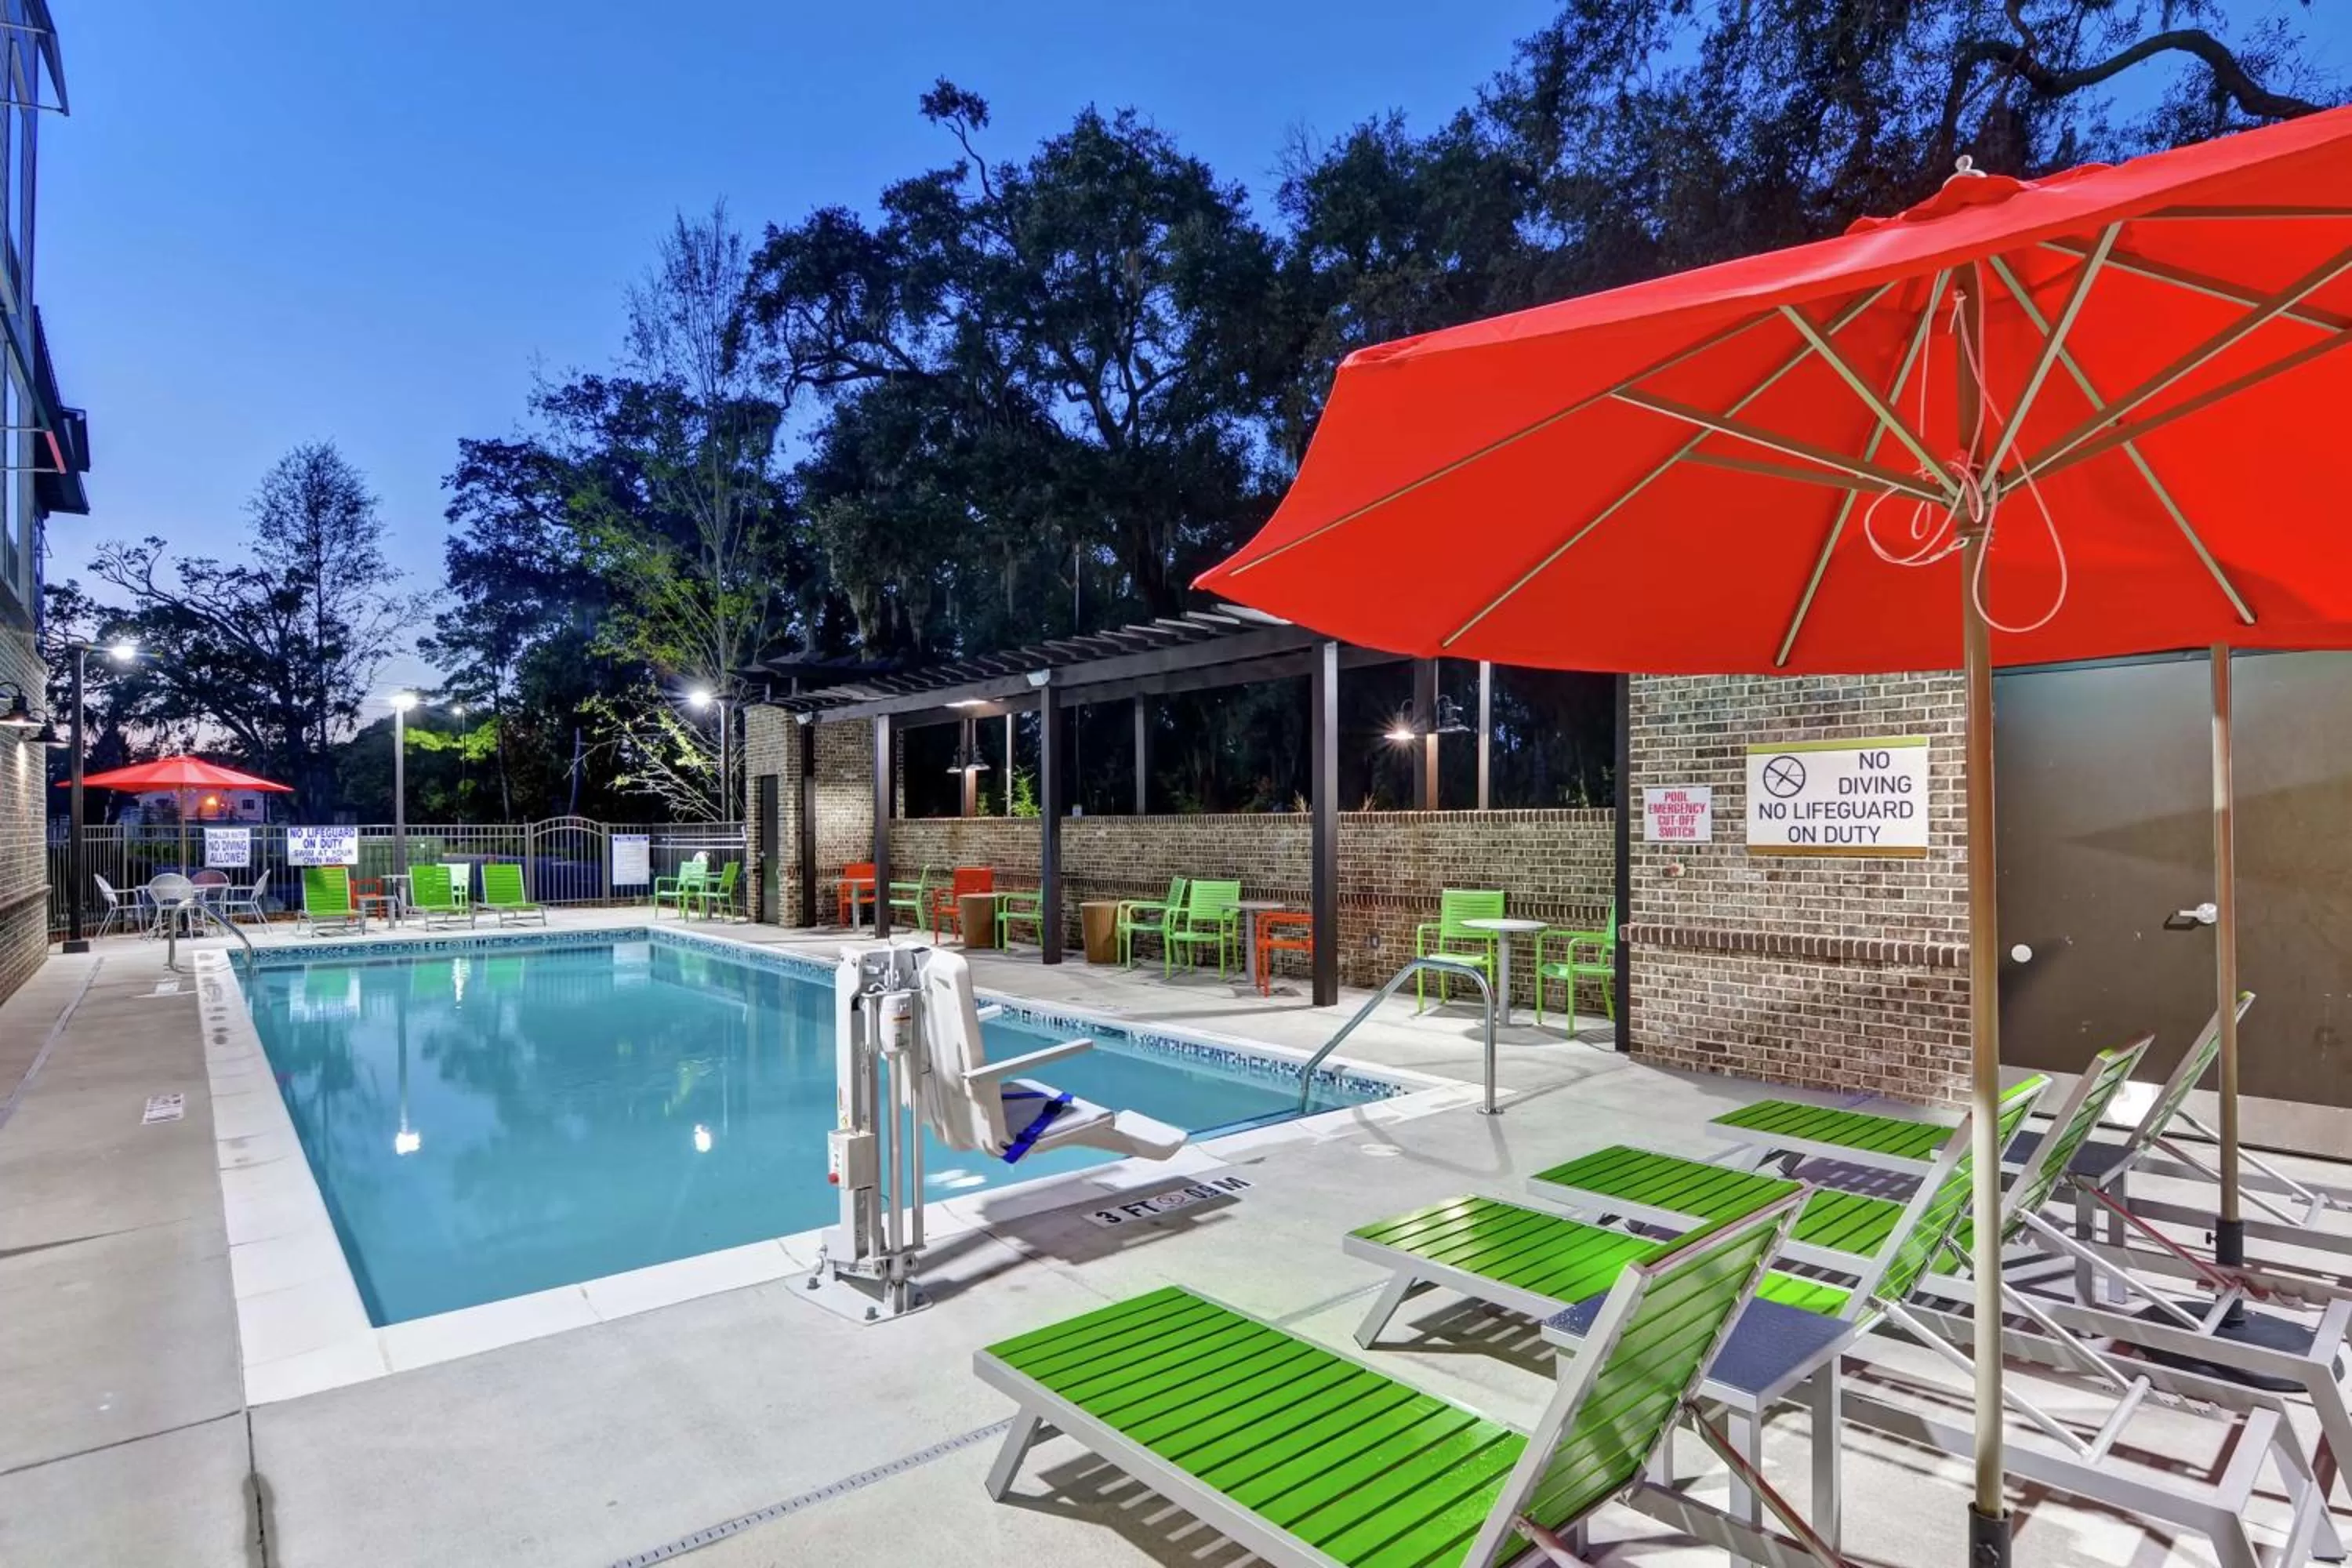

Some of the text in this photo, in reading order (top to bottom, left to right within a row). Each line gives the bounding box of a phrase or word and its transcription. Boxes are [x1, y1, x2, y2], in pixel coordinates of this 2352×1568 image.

[1859, 751, 1890, 770] NO
[1838, 775, 1912, 795] DIVING
[1664, 791, 1687, 801] POOL
[1648, 803, 1706, 814] EMERGENCY
[1759, 800, 1914, 820] NO LIFEGUARD
[290, 828, 355, 838] NO LIFEGUARD
[1658, 827, 1696, 837] SWITCH
[1788, 826, 1881, 844] ON DUTY
[209, 840, 247, 851] NO DIVING
[303, 838, 343, 848] ON DUTY
[209, 851, 246, 863] ALLOWED
[1095, 1210, 1122, 1224] 3
[1120, 1200, 1161, 1218] FT
[1212, 1177, 1252, 1192] M
